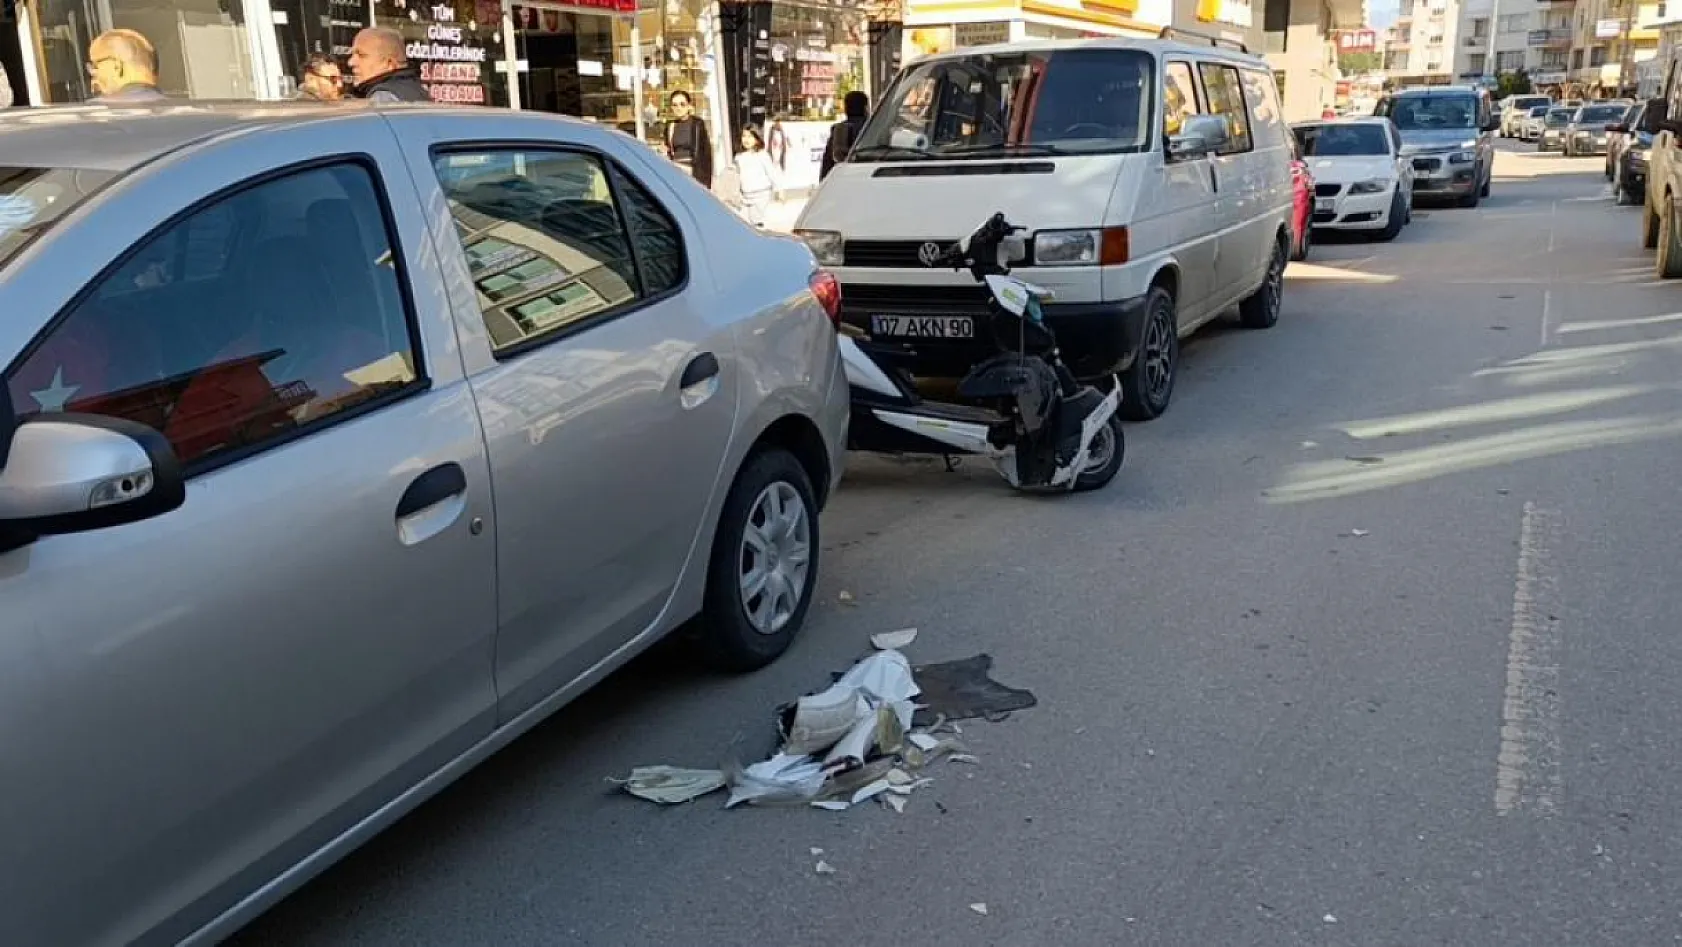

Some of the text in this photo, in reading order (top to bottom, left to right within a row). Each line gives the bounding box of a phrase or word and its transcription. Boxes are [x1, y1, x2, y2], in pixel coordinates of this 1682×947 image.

[431, 4, 454, 21] TÜM
[907, 318, 944, 337] AKN
[949, 319, 972, 337] 90
